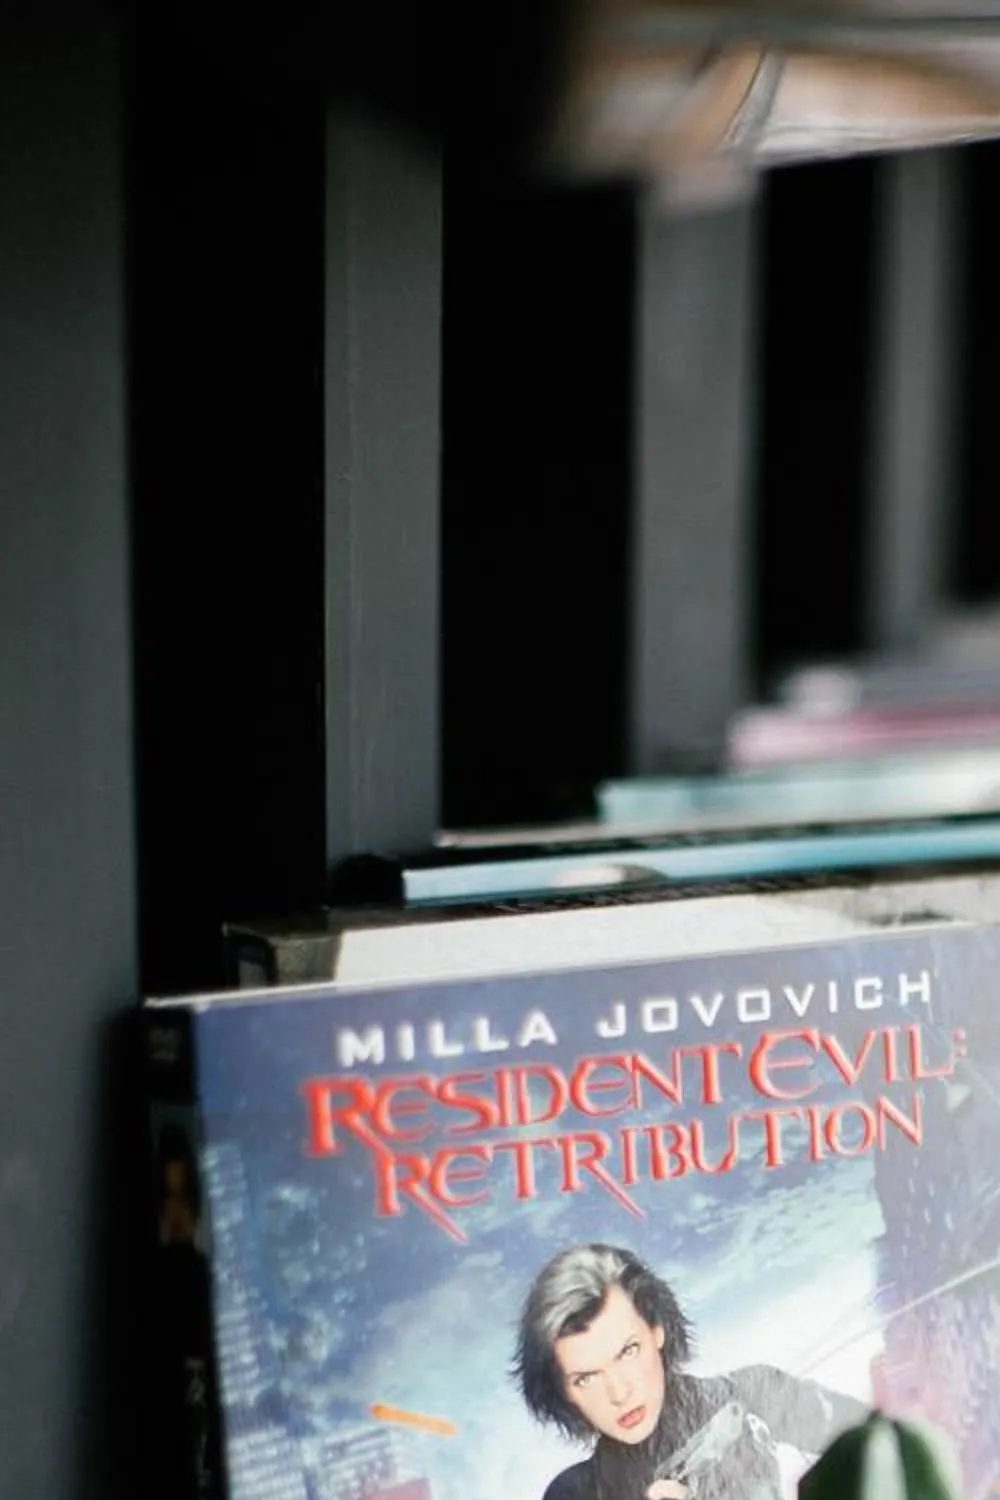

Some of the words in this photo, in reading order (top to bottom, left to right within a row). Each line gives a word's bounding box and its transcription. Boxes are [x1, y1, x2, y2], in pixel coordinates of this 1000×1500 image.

[338, 1011, 558, 1068] MILLA
[598, 970, 932, 1040] JOVOVICH
[304, 1042, 742, 1158] RESIDENT
[374, 1094, 924, 1246] RETRIBUTION
